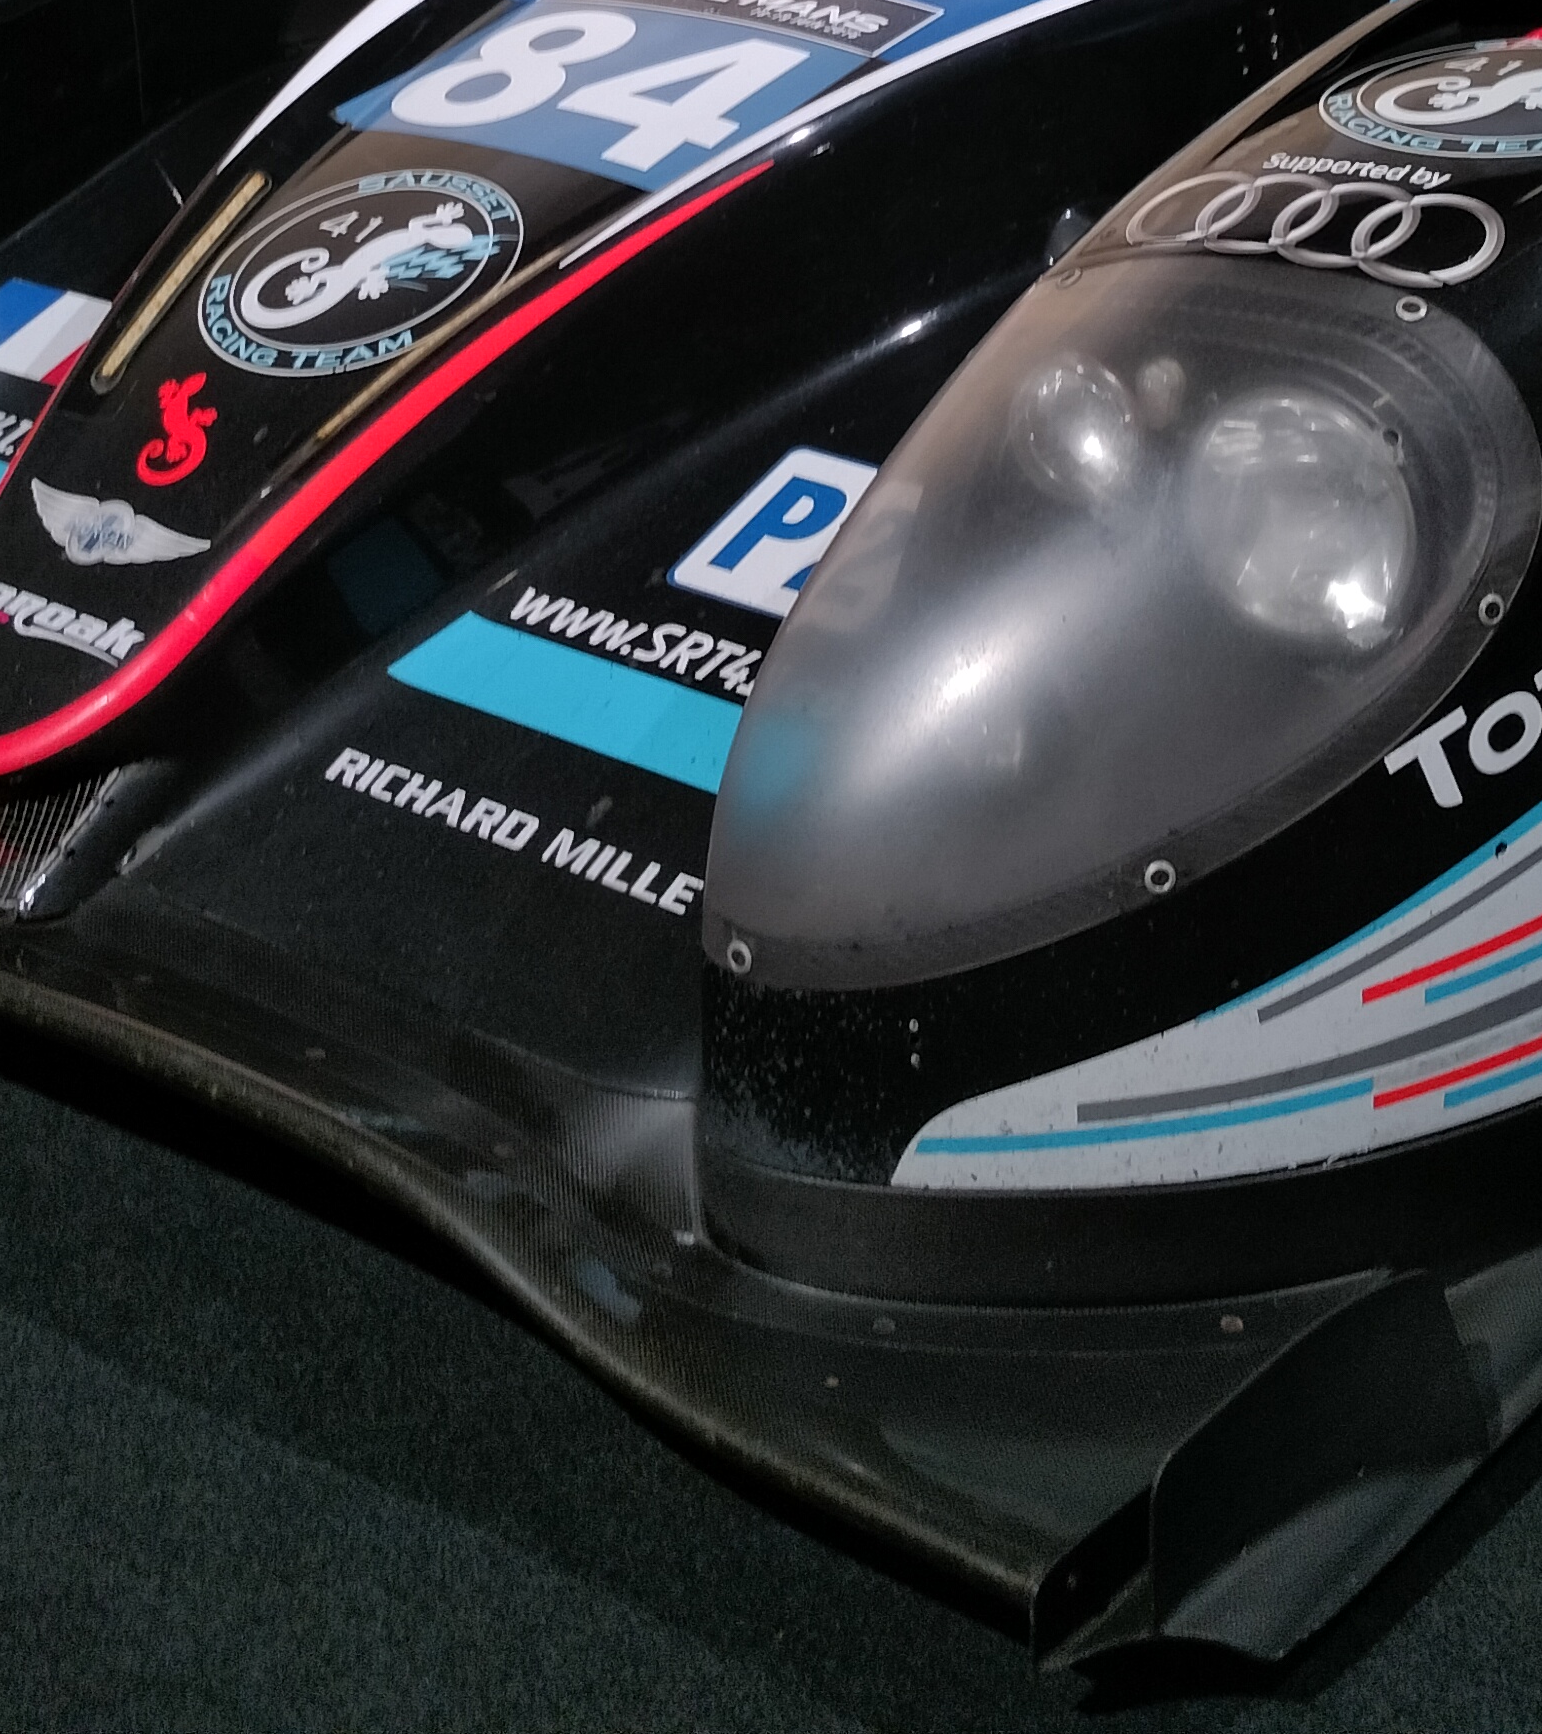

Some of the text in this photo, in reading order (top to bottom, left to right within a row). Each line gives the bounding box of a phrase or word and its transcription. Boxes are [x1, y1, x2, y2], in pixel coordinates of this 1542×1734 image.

[391, 9, 811, 174] 84
[1328, 92, 1443, 151] RACING
[358, 169, 516, 224] SAUSSET
[1409, 166, 1453, 190] by
[320, 210, 384, 243] 41
[205, 274, 414, 371] RACING TEAM
[708, 476, 848, 592] P
[324, 747, 705, 916] RICHARD MILLE
